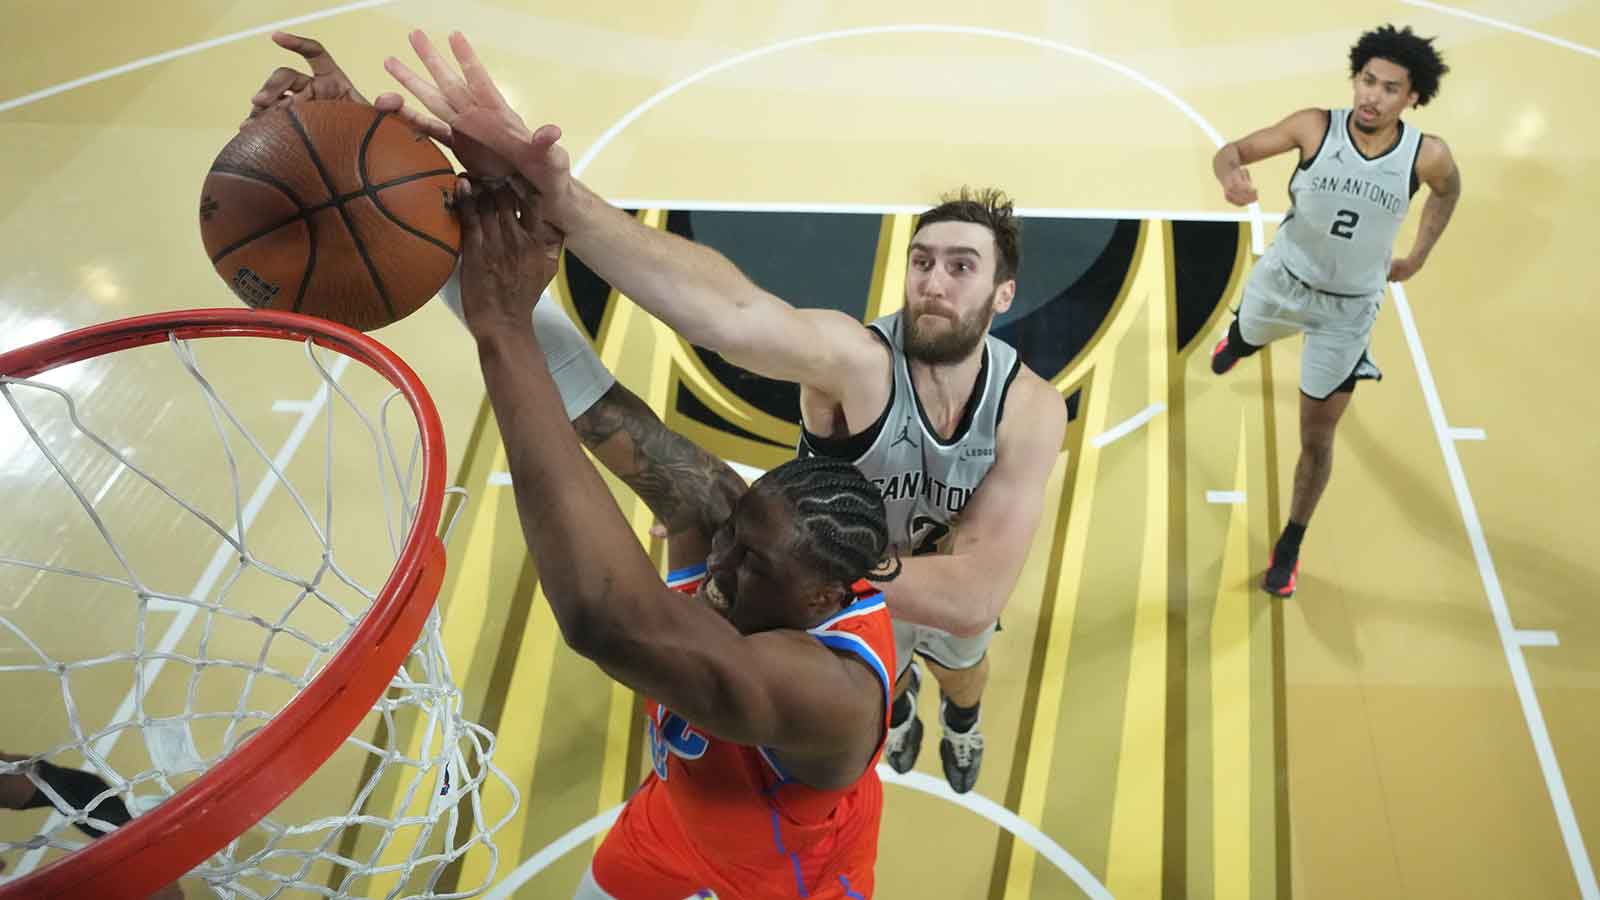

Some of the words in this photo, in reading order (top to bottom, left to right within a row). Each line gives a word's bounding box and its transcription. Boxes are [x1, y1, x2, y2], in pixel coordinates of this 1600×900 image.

[1311, 175, 1339, 193] SAN
[1341, 177, 1401, 215] ANTONIO
[1330, 209, 1359, 239] 2
